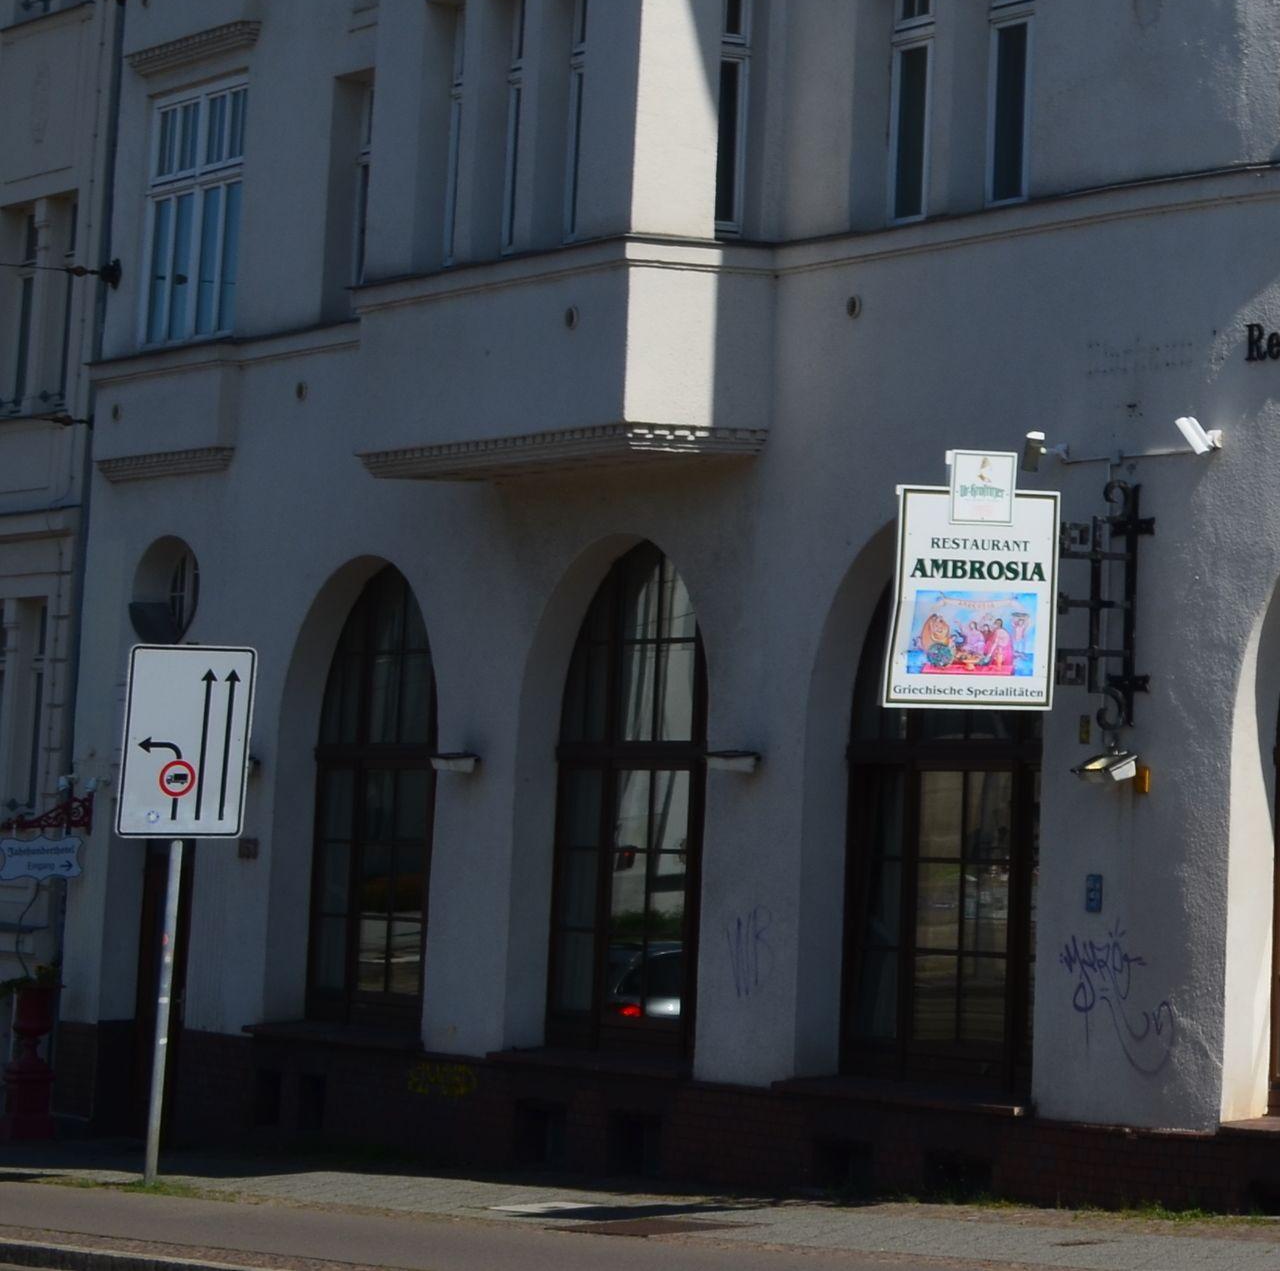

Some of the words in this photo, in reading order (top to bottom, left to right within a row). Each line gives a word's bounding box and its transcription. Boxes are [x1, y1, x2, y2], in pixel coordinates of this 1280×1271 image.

[930, 537, 1030, 552] RESTAURANT
[909, 558, 1047, 582] AMBROSIA
[893, 685, 964, 696] Griechische
[966, 686, 1044, 699] Spezialitäten
